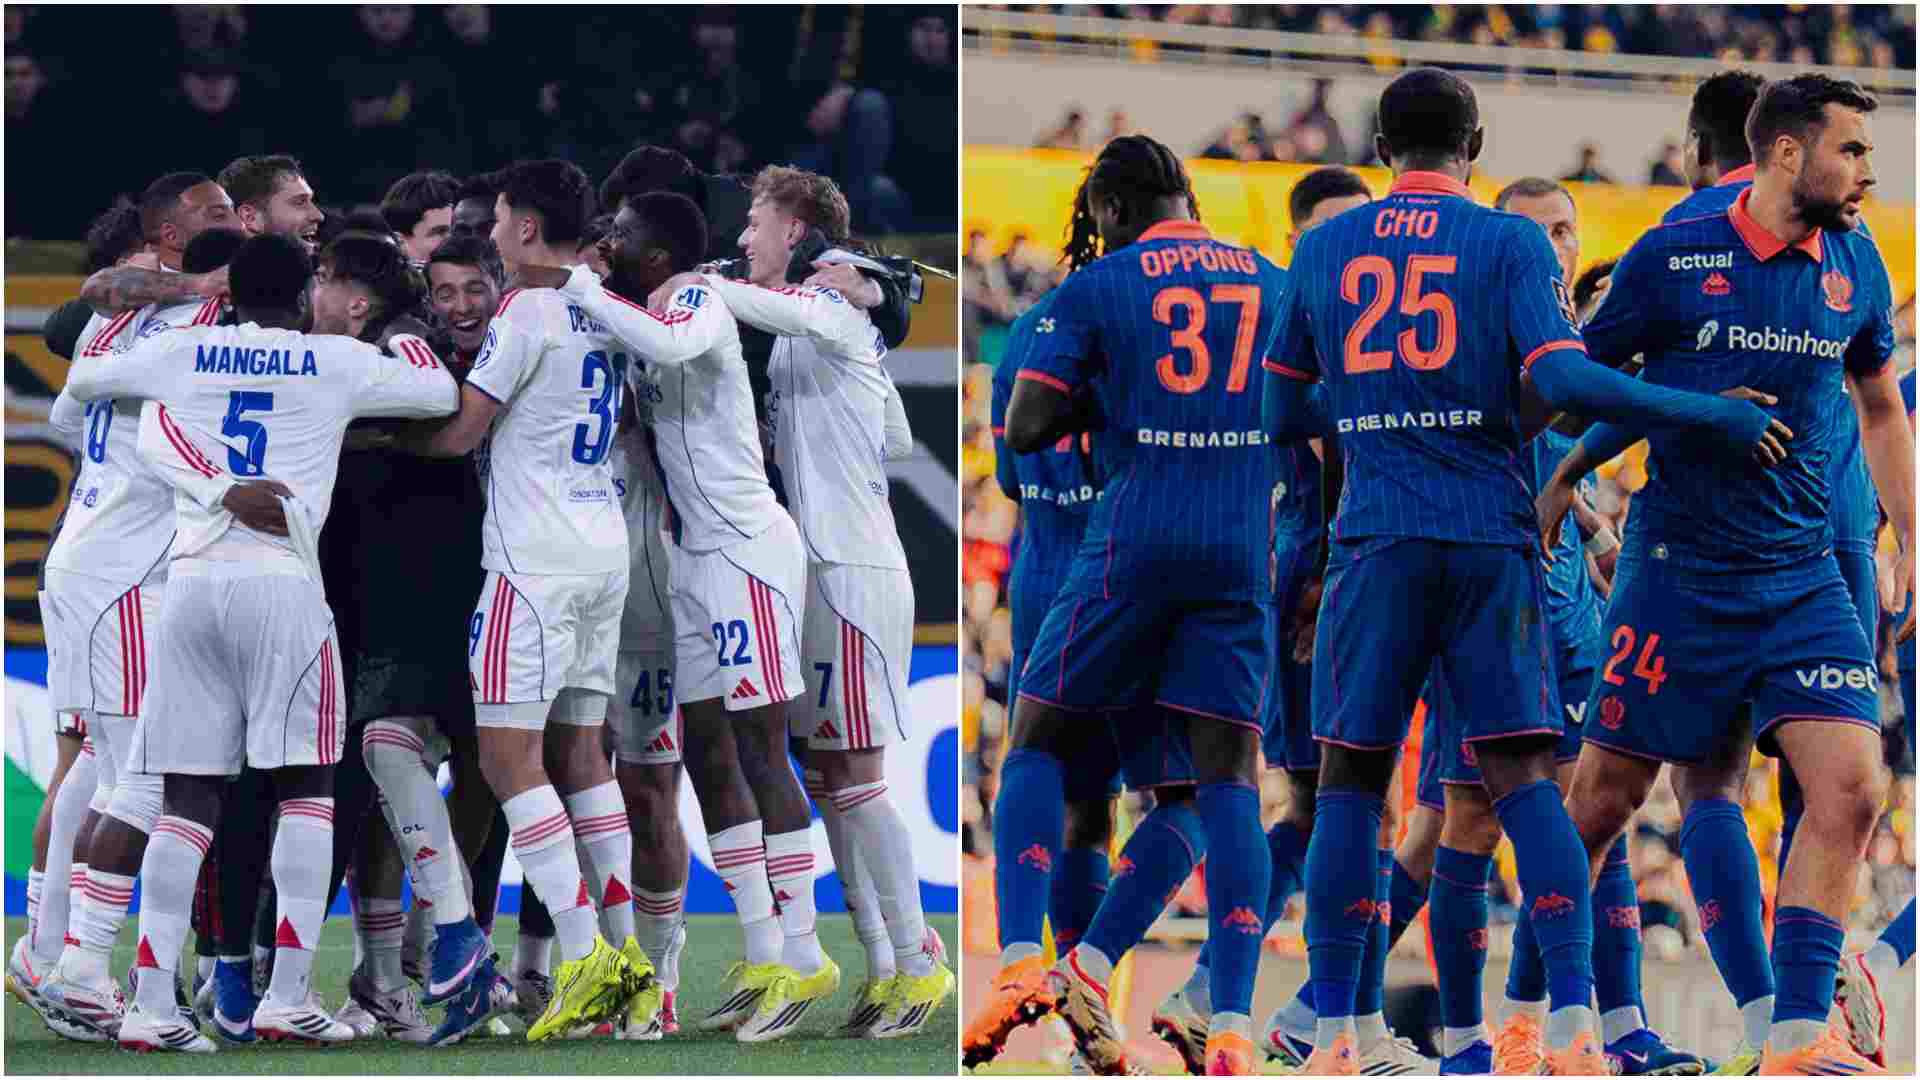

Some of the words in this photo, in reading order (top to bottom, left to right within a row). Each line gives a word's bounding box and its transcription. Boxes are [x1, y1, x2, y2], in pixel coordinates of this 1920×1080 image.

[1375, 207, 1439, 238] CHO
[1140, 244, 1259, 277] OPPONG
[1668, 251, 1733, 271] actual
[1340, 255, 1457, 374] 25
[194, 345, 317, 376] MANGALA
[1151, 284, 1262, 394] 37
[222, 390, 274, 477] 5
[1337, 410, 1483, 433] GRENADIER
[711, 619, 753, 667] 22
[1602, 624, 1669, 696] 24
[630, 669, 673, 716] 45
[814, 662, 833, 708] 7
[1795, 664, 1878, 692] vbet
